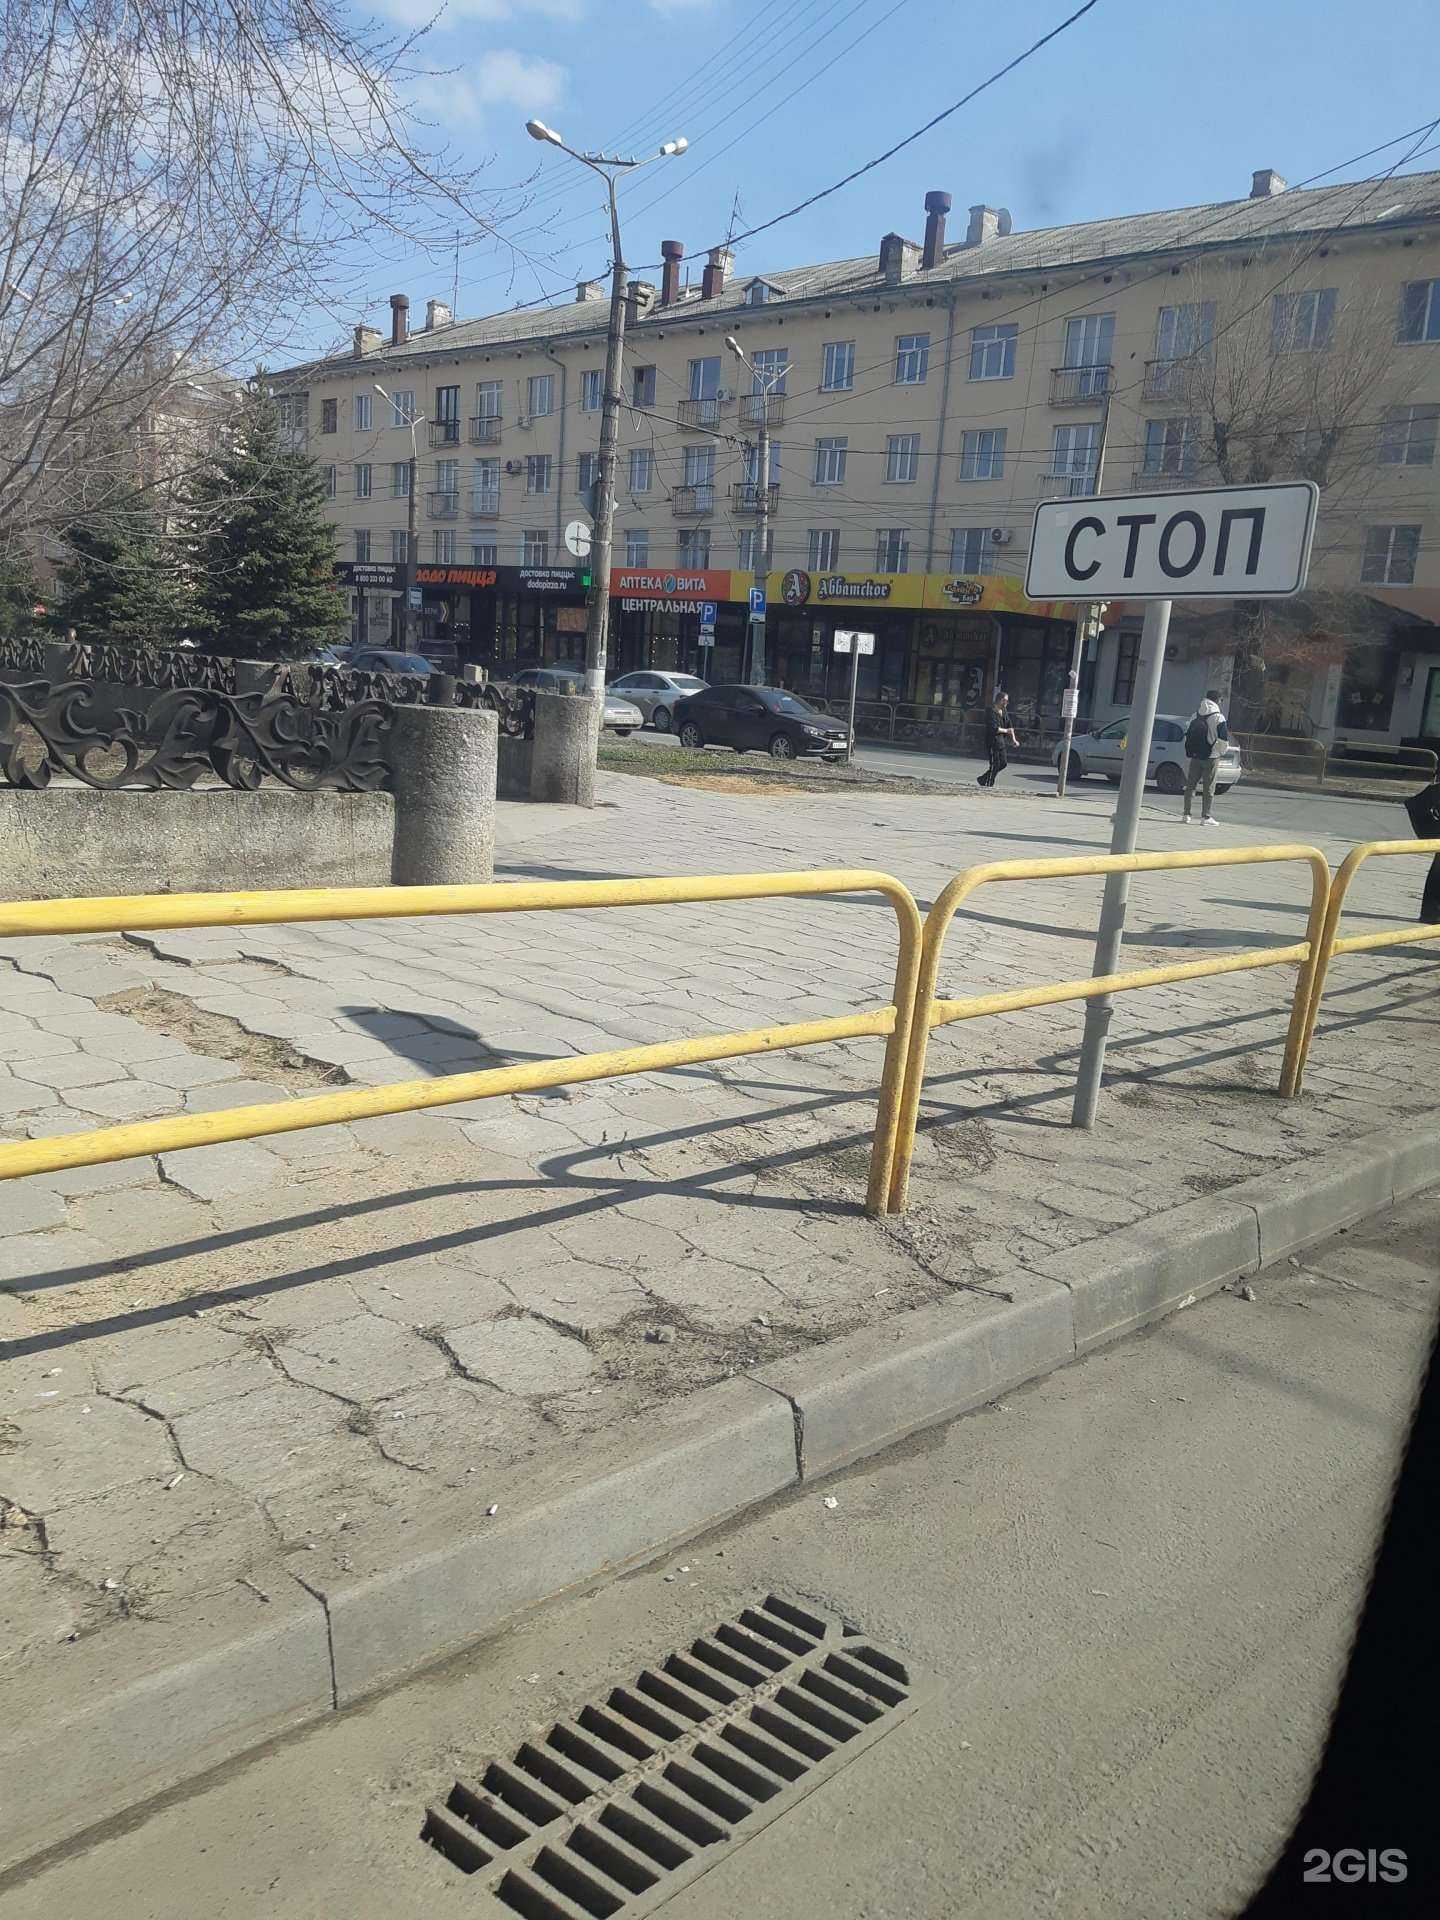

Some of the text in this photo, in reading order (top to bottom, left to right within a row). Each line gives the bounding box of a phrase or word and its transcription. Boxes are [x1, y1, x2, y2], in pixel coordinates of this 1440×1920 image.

[1064, 508, 1266, 582] СТОП
[527, 579, 567, 591] dodopizza.ru
[619, 576, 707, 592] АПТЕКА ВИТА
[621, 598, 703, 615] ЦЕНТРАЛЬНАЯ
